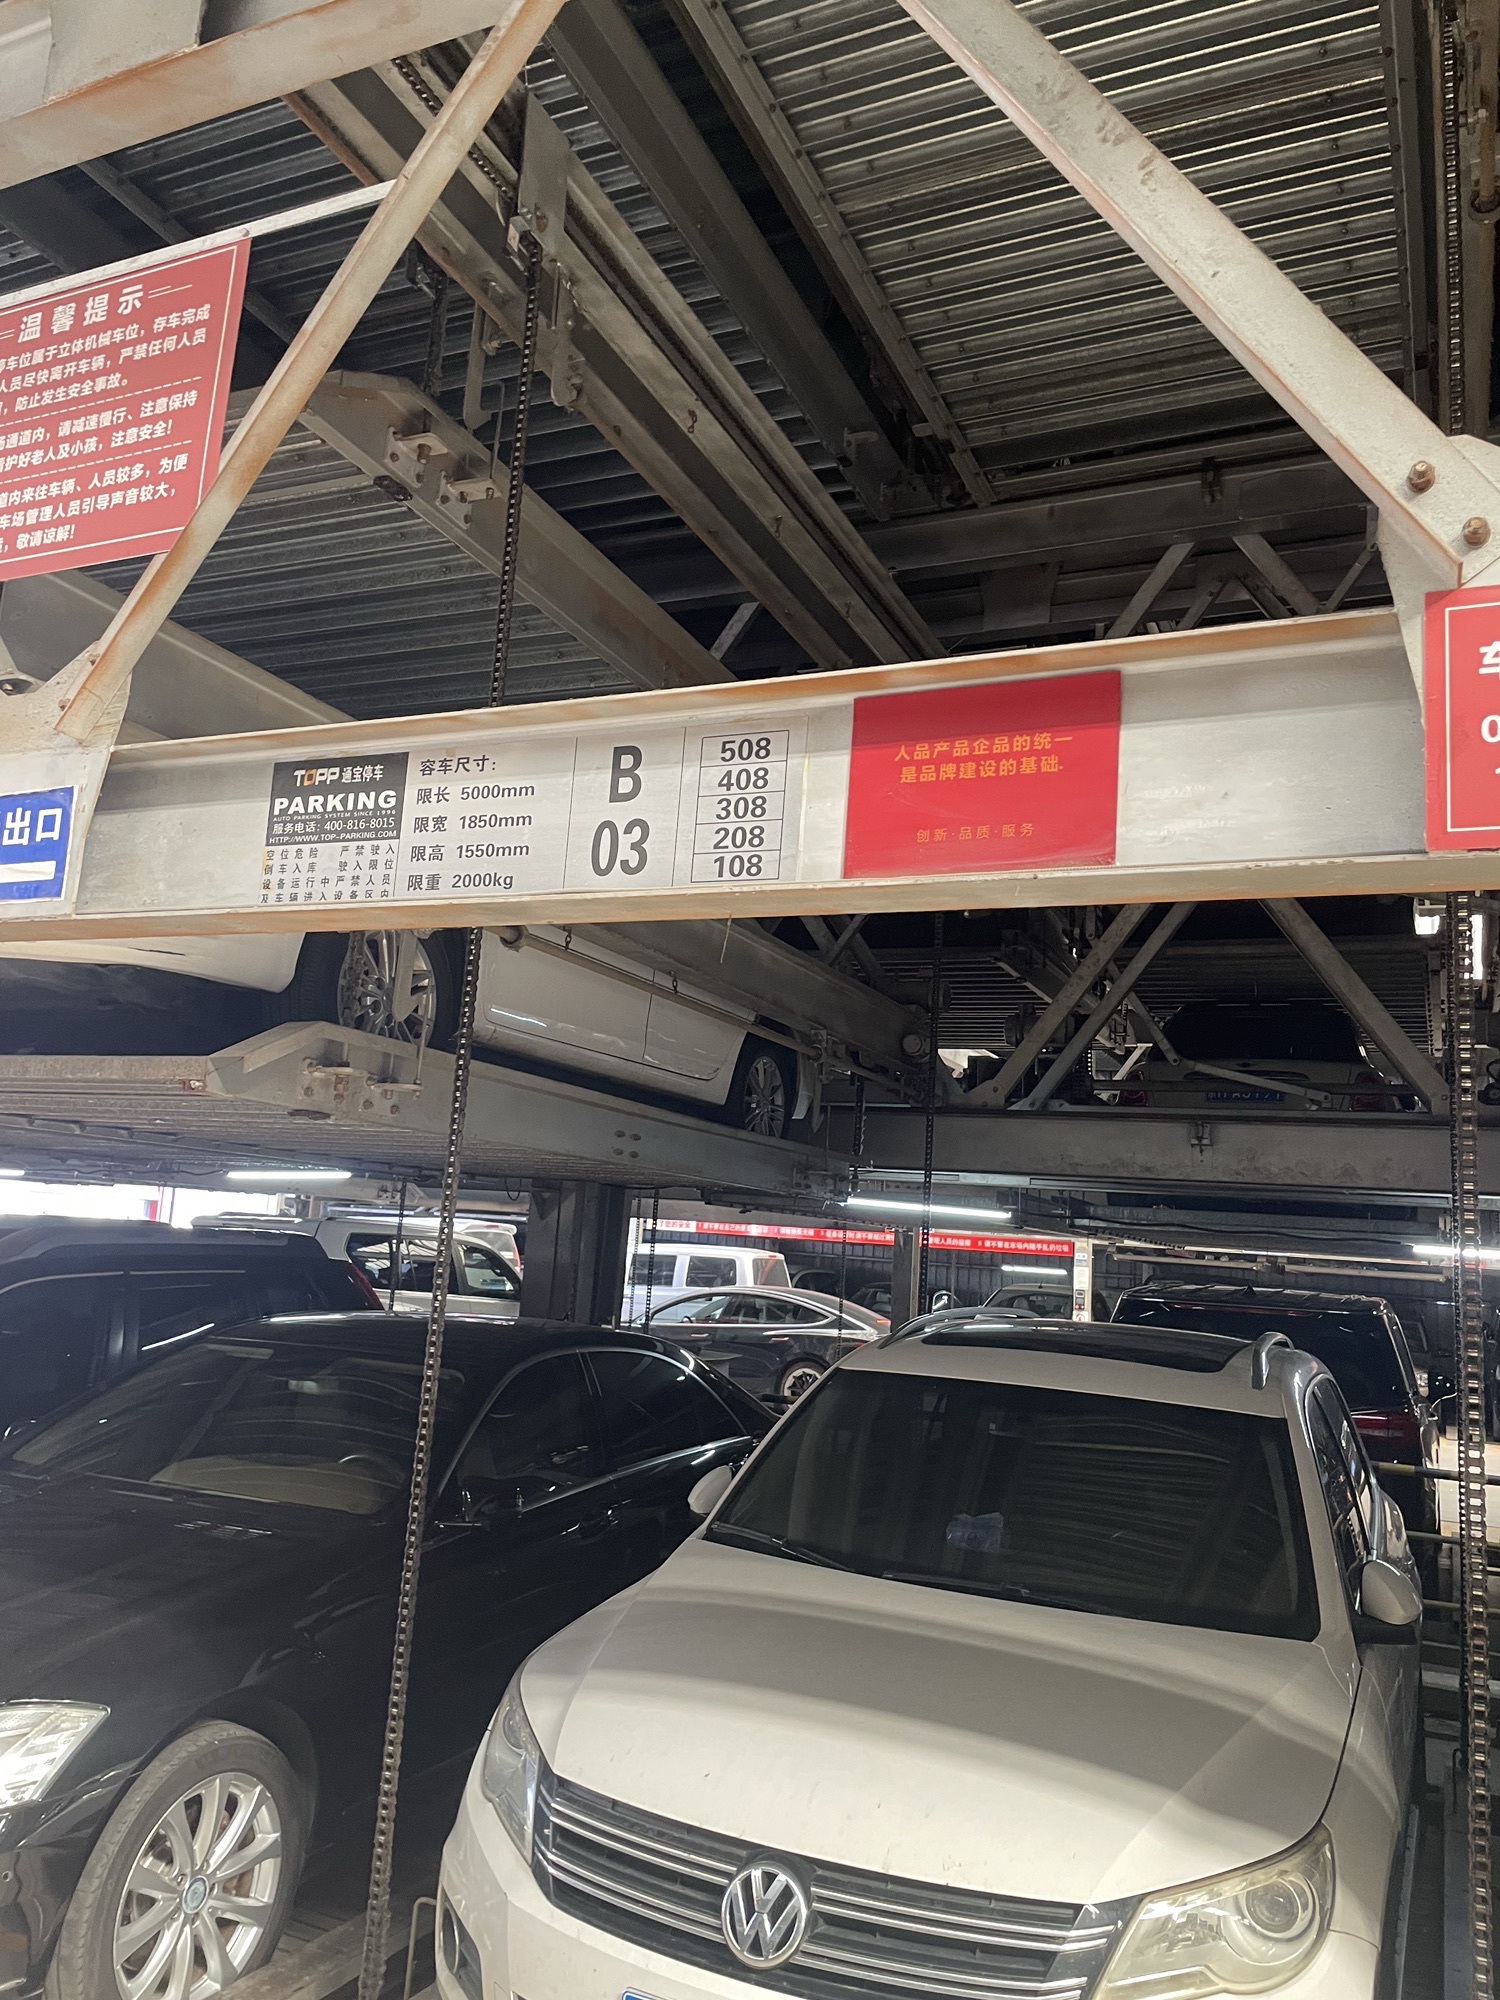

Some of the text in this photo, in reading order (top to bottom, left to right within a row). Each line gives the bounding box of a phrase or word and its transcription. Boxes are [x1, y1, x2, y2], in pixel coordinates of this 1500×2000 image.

[18, 284, 144, 343] 温馨提示
[720, 737, 771, 763] 508
[894, 731, 1073, 762] 人品产品企品的统一
[293, 764, 384, 787] TOPP 通宝停车
[609, 745, 643, 803] B
[718, 767, 769, 791] 408
[273, 790, 397, 816] PARKING
[416, 784, 535, 805] 限长 5000mm
[715, 795, 767, 820] 308
[323, 817, 395, 831] 400-816-8015
[413, 813, 532, 834] 限宽 1850mm
[591, 818, 650, 876] 03
[713, 825, 765, 850] 208
[410, 843, 530, 863] 限高 1550mm
[713, 853, 763, 878] 108
[407, 872, 514, 892] 限重 2000kg
